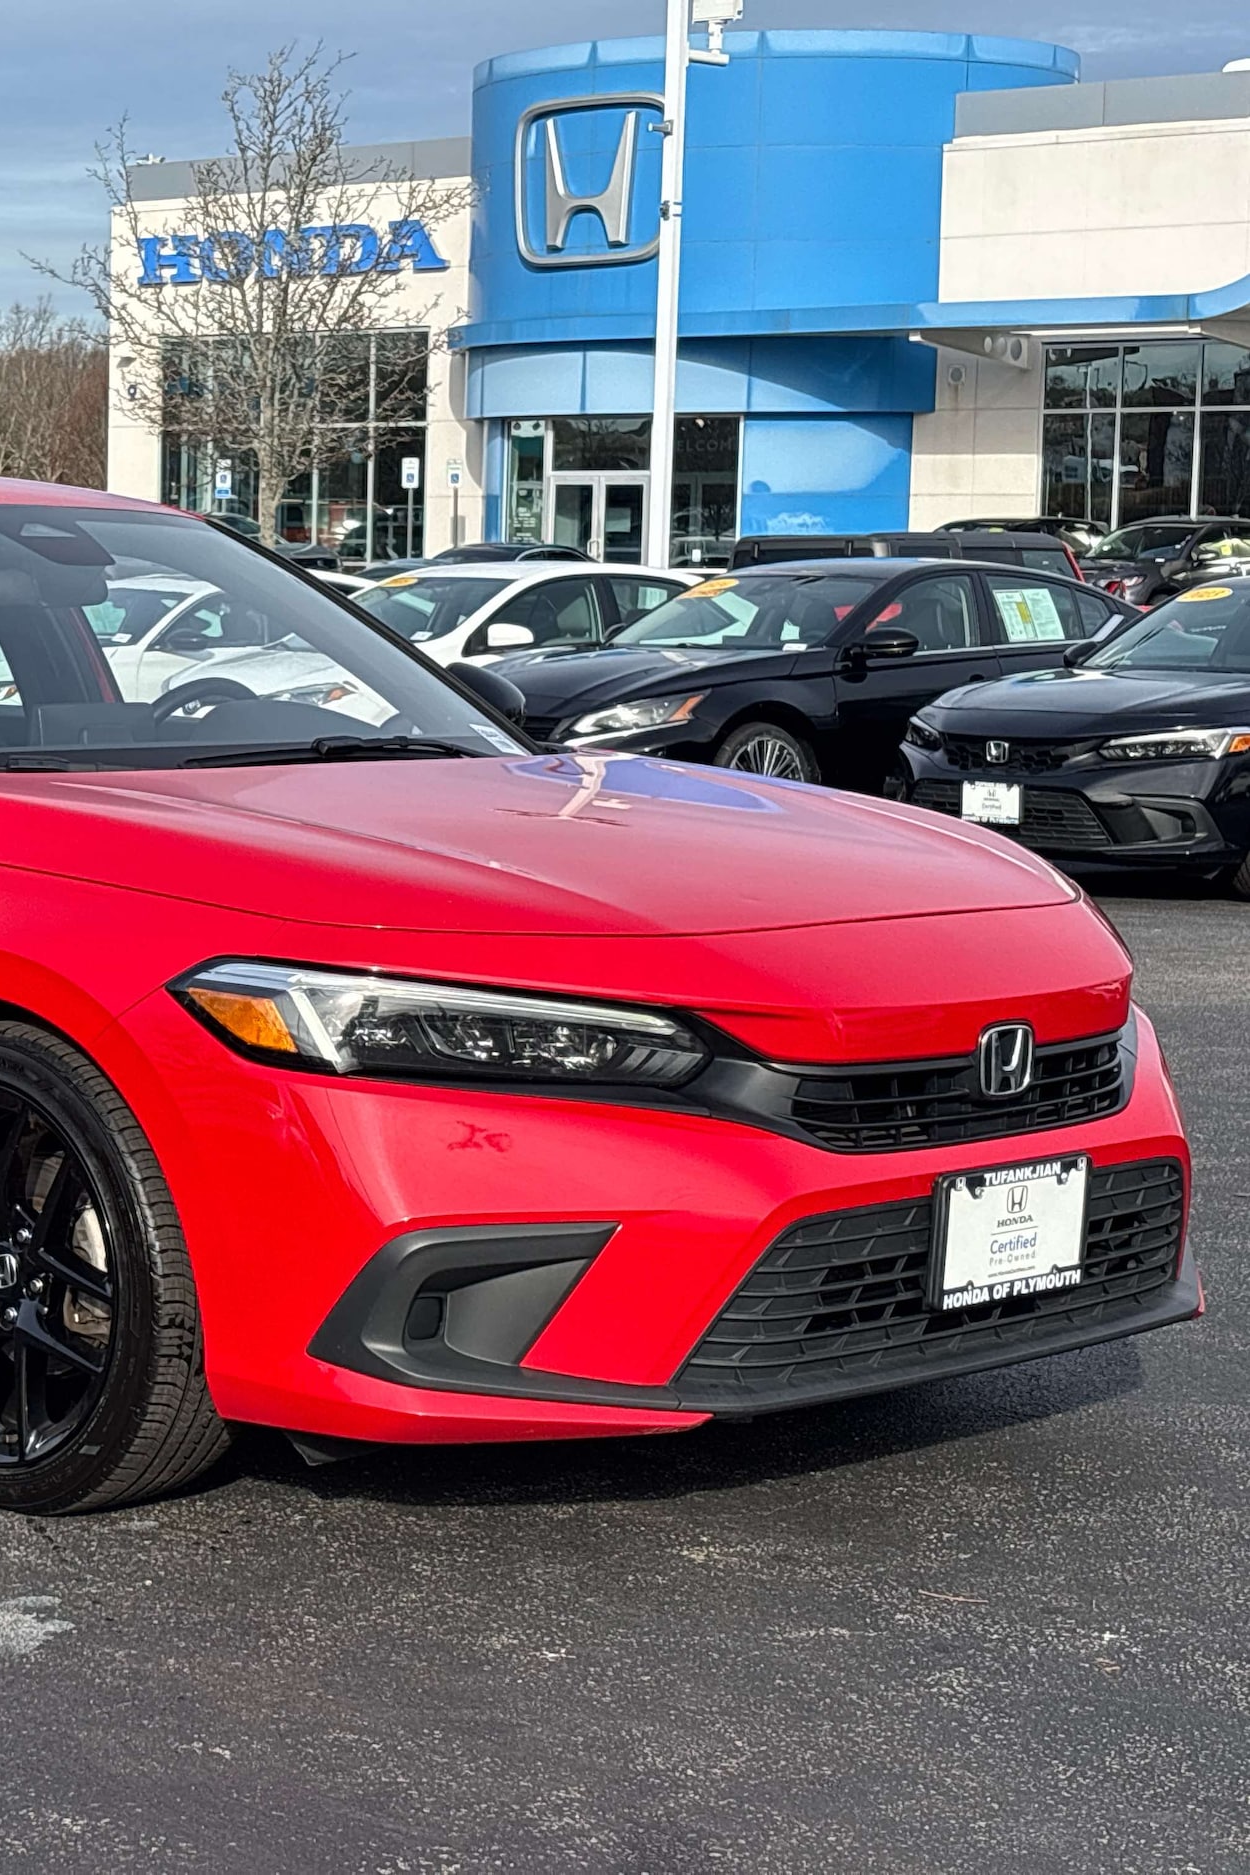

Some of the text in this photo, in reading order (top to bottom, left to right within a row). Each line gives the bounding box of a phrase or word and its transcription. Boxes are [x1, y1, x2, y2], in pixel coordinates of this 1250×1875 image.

[138, 219, 449, 286] HONDA
[984, 1161, 1061, 1187] TUFANKJIAN
[997, 1214, 1034, 1228] HONDA
[990, 1231, 1037, 1254] Certified
[943, 1286, 990, 1310] HONDA
[993, 1282, 1010, 1300] OF
[1013, 1269, 1081, 1296] PLYMOUTH
